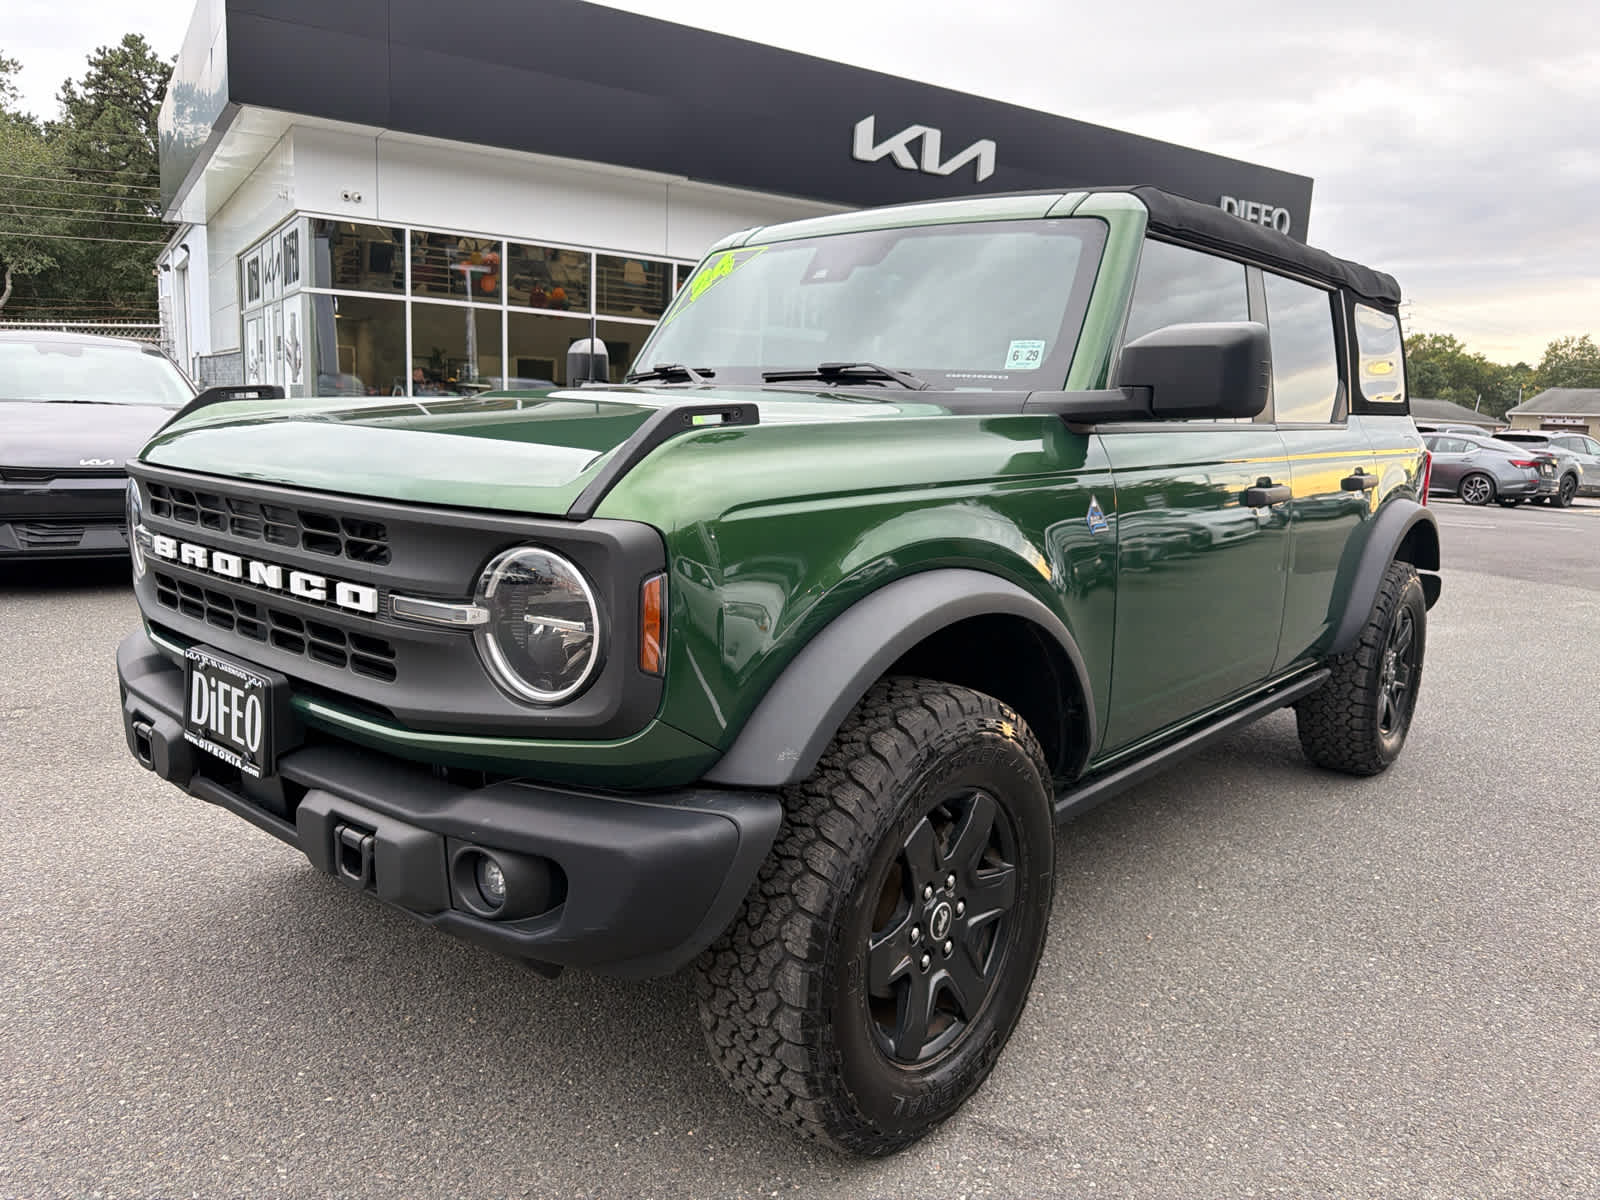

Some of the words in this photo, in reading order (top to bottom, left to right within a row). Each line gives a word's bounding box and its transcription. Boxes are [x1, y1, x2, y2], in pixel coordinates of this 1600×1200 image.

[853, 115, 997, 182] KIA
[1012, 350, 1020, 361] 6
[1025, 350, 1040, 361] 29
[154, 534, 378, 613] BRONCO
[191, 670, 262, 753] DiFEO
